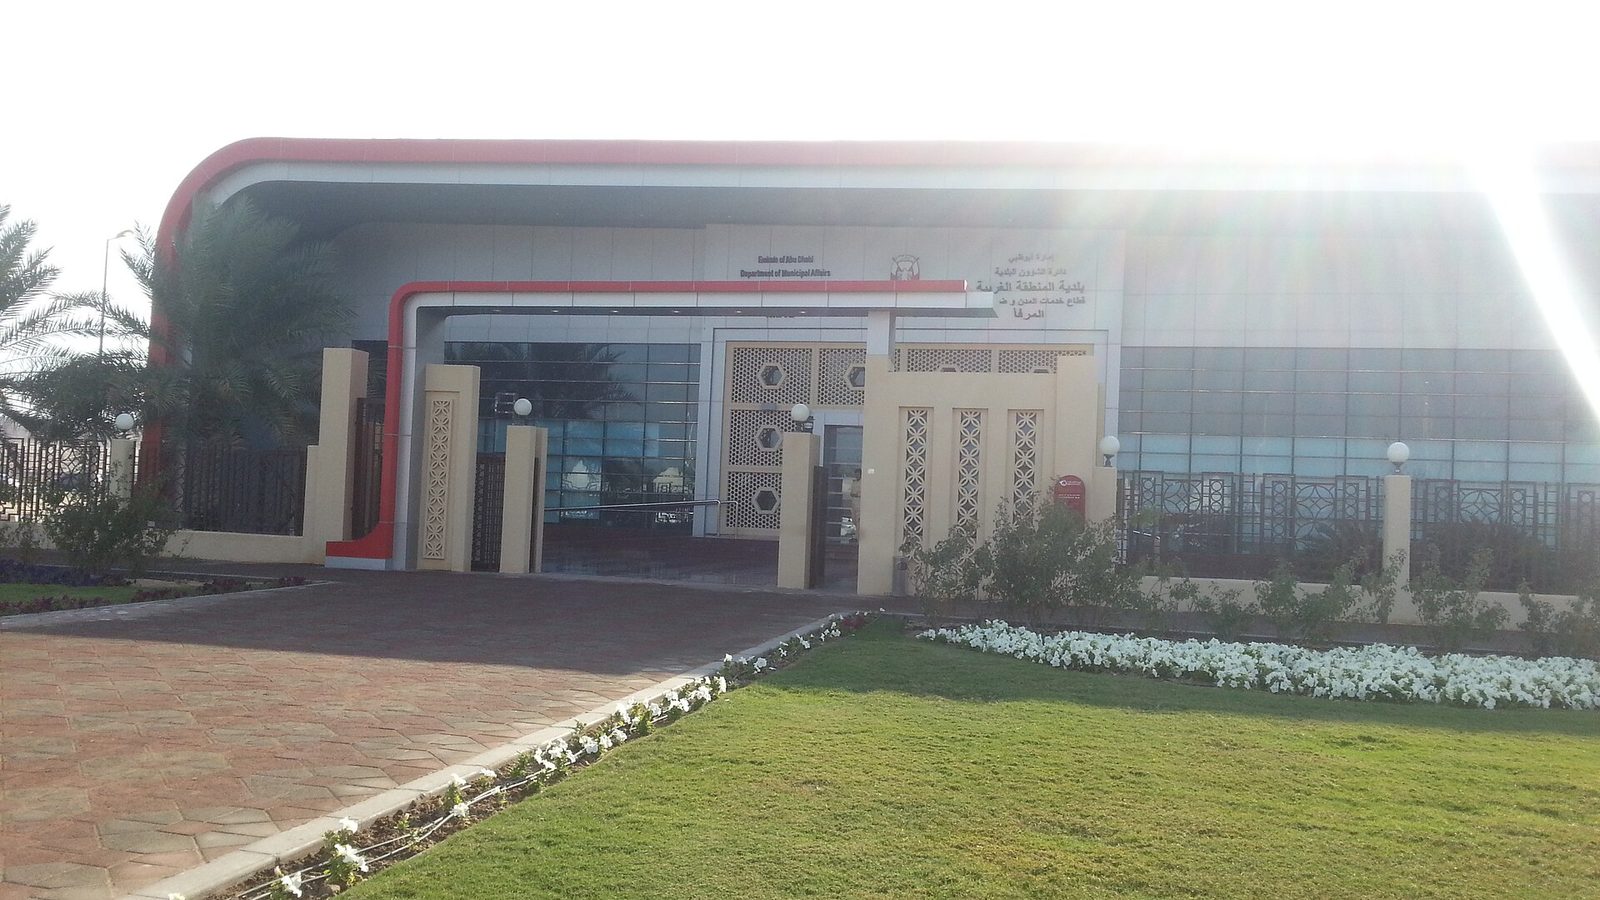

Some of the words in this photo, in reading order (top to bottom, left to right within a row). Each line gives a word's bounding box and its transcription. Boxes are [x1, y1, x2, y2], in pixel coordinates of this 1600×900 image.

[779, 255, 785, 264] of
[785, 255, 797, 264] Abu
[798, 255, 814, 264] Dhabi
[740, 269, 774, 279] Department
[775, 269, 781, 278] of
[782, 269, 810, 279] Municipal
[810, 269, 831, 278] Affairs
[1016, 280, 1055, 292] المنطقة
[1059, 280, 1085, 294] بلدية
